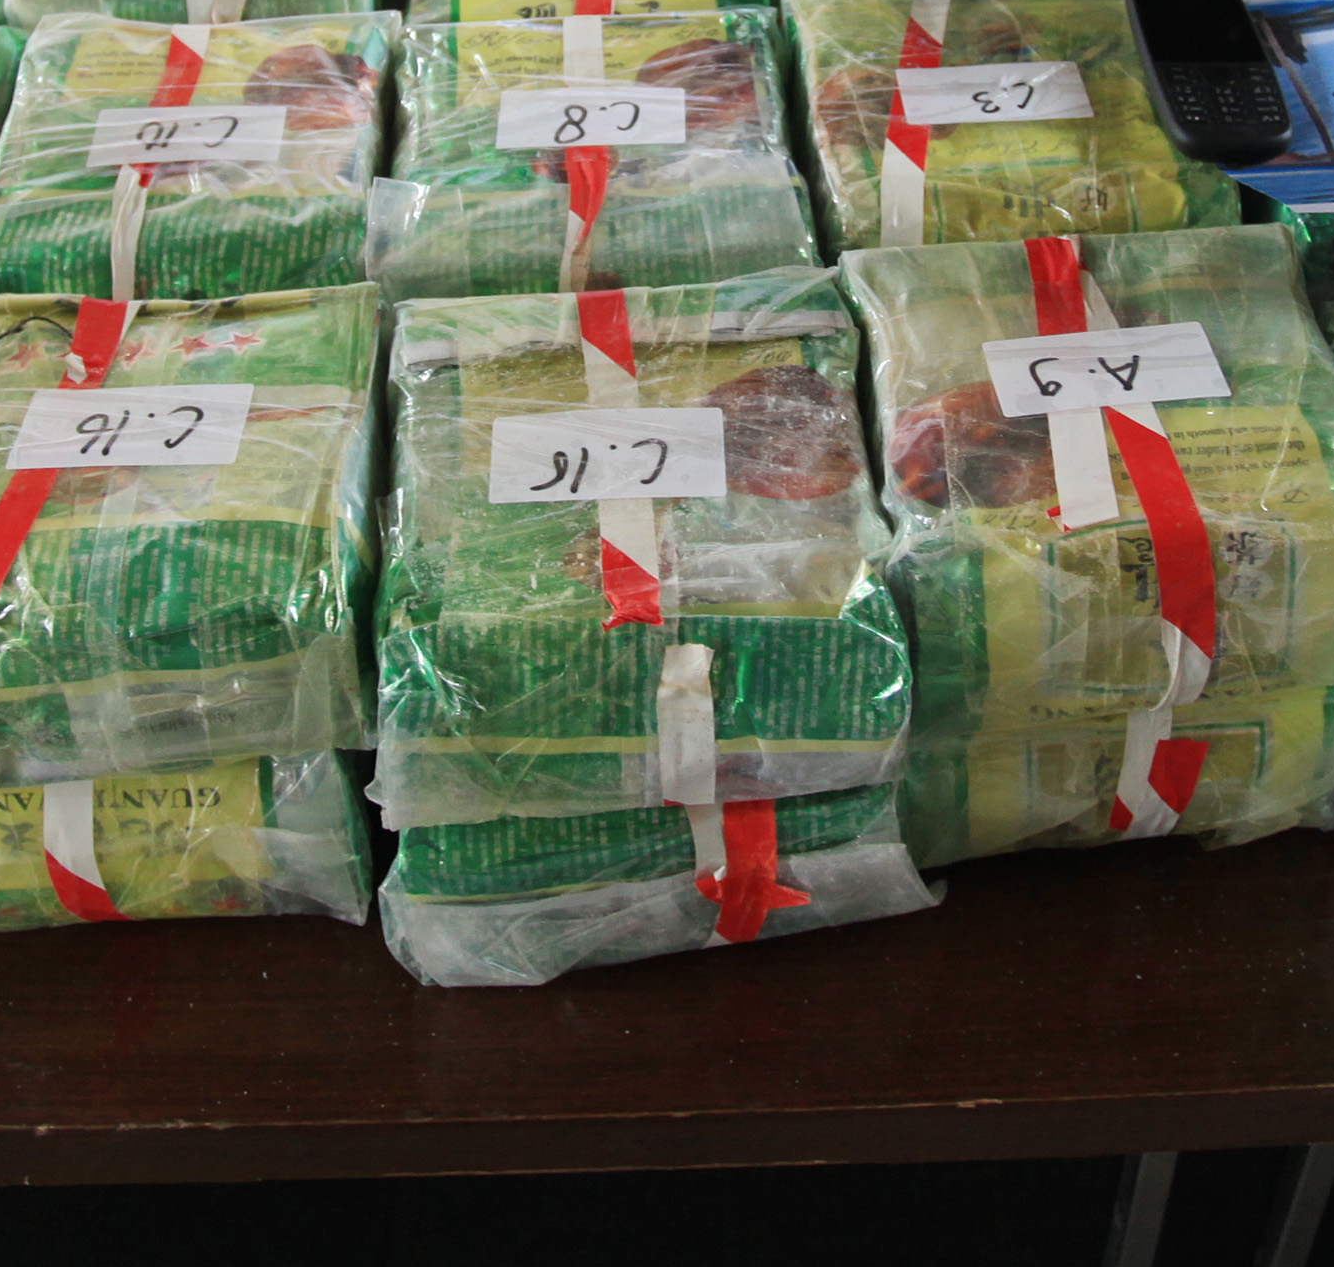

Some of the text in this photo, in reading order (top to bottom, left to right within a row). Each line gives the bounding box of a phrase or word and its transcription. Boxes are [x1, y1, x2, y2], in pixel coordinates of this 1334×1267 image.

[971, 81, 1036, 114] C.3
[553, 102, 639, 144] C.8
[1028, 353, 1142, 396] A.9
[75, 404, 205, 456] C.16
[529, 437, 669, 493] C.16
